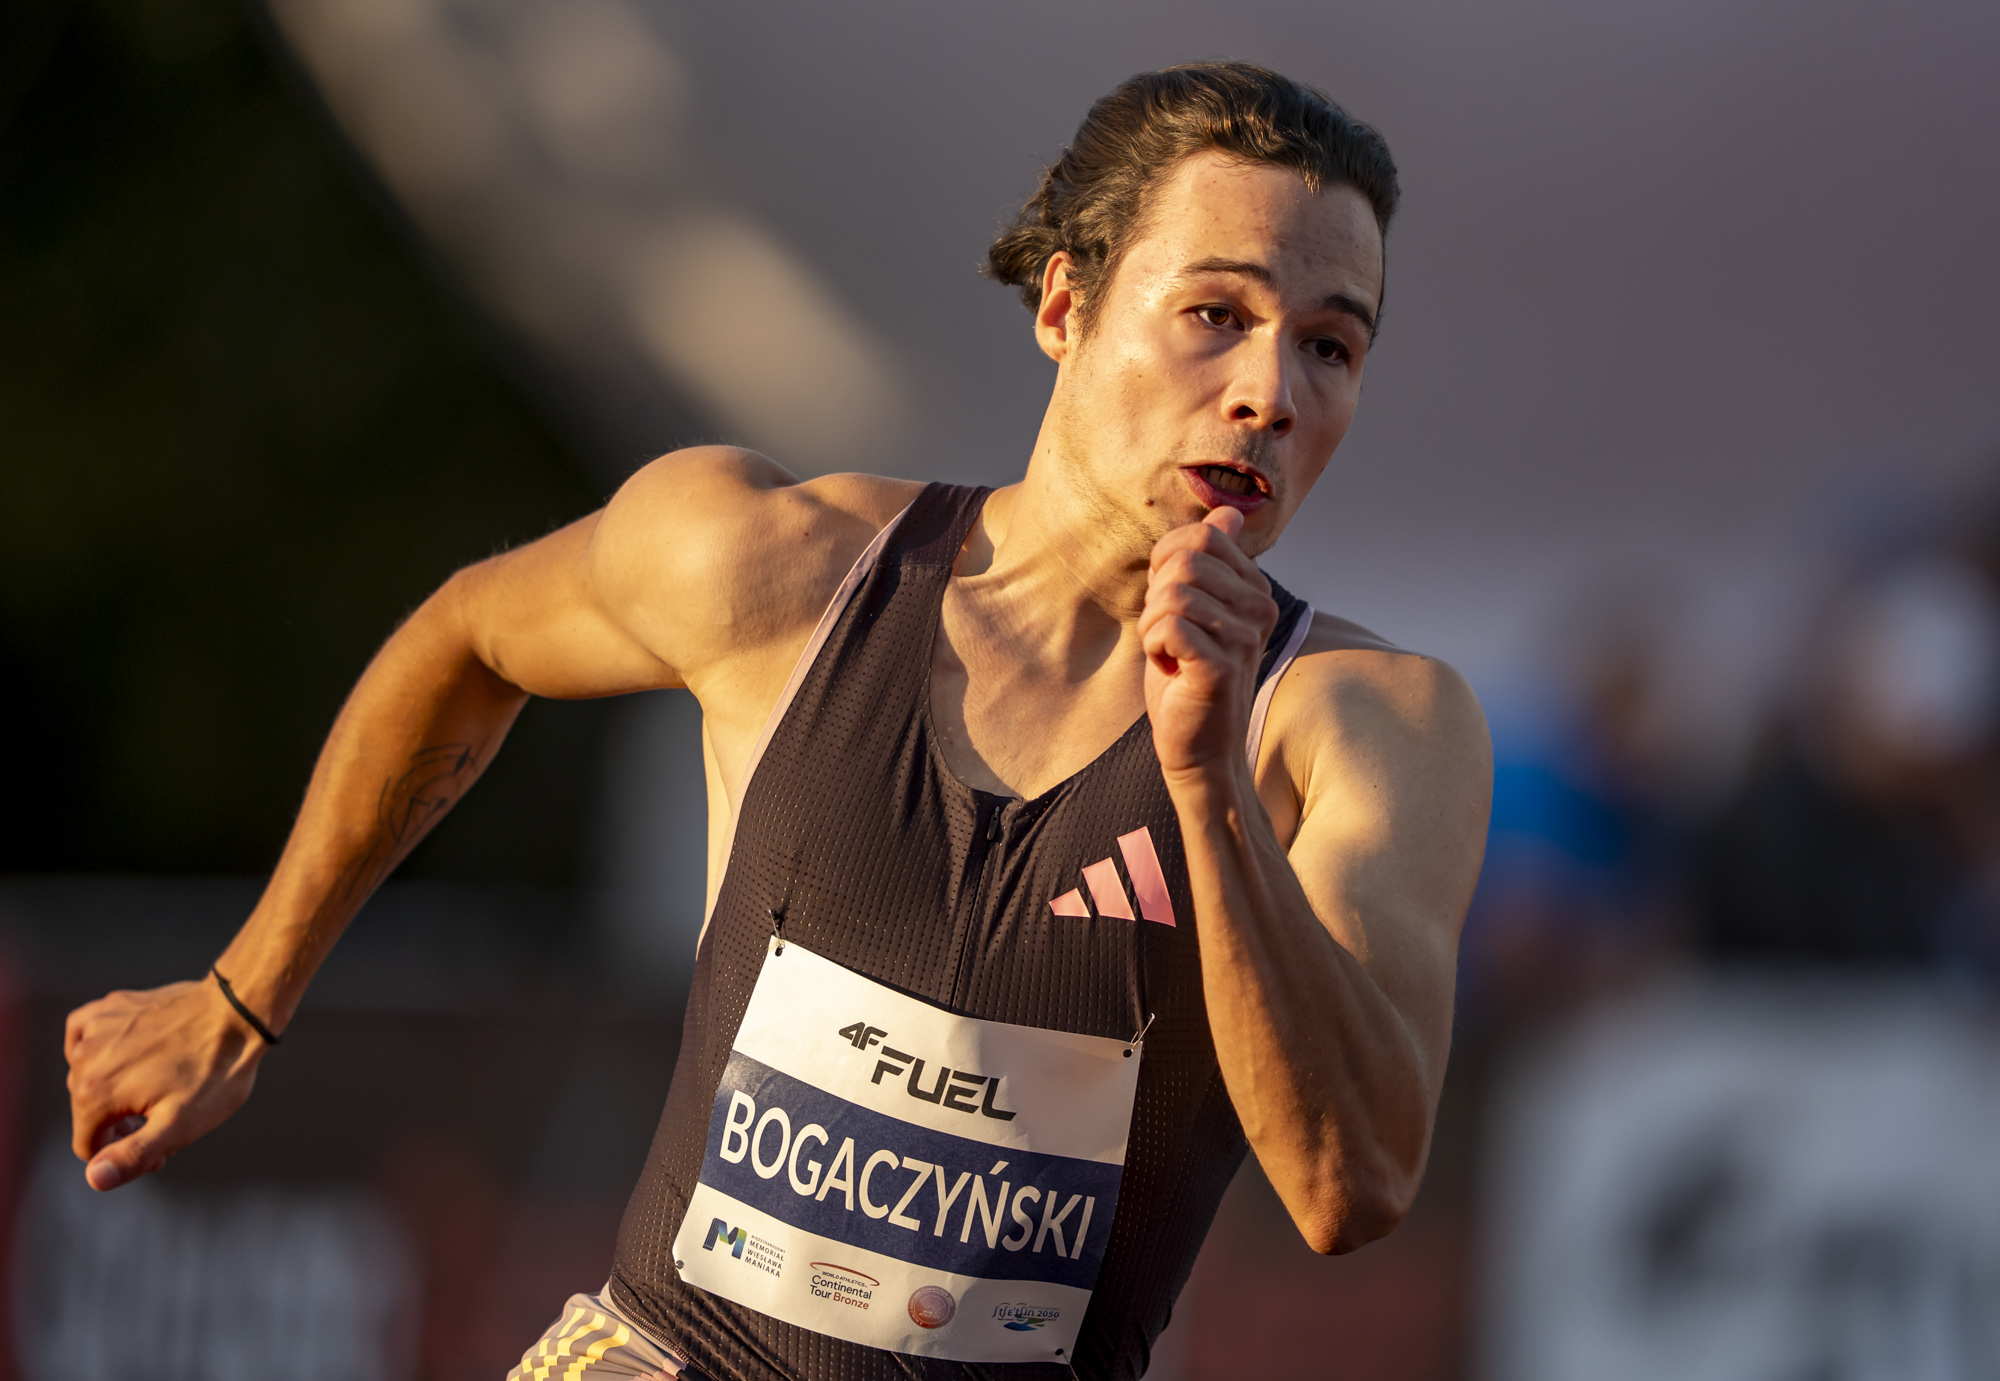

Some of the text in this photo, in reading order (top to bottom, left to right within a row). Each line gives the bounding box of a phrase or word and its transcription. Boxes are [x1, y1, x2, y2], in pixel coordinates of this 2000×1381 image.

[838, 1021, 889, 1051] 4F
[870, 1045, 1018, 1122] FUEL
[719, 1089, 1096, 1261] BOGACZYŃSKI
[747, 1248, 782, 1270] WIESŁAWA
[749, 1240, 784, 1261] MEMORIAŁ
[744, 1256, 780, 1278] MANIAKA
[822, 1271, 839, 1279] WORLD
[809, 1284, 870, 1310] Tour Bronze
[811, 1274, 873, 1300] Continental
[1036, 1310, 1060, 1318] 2050
